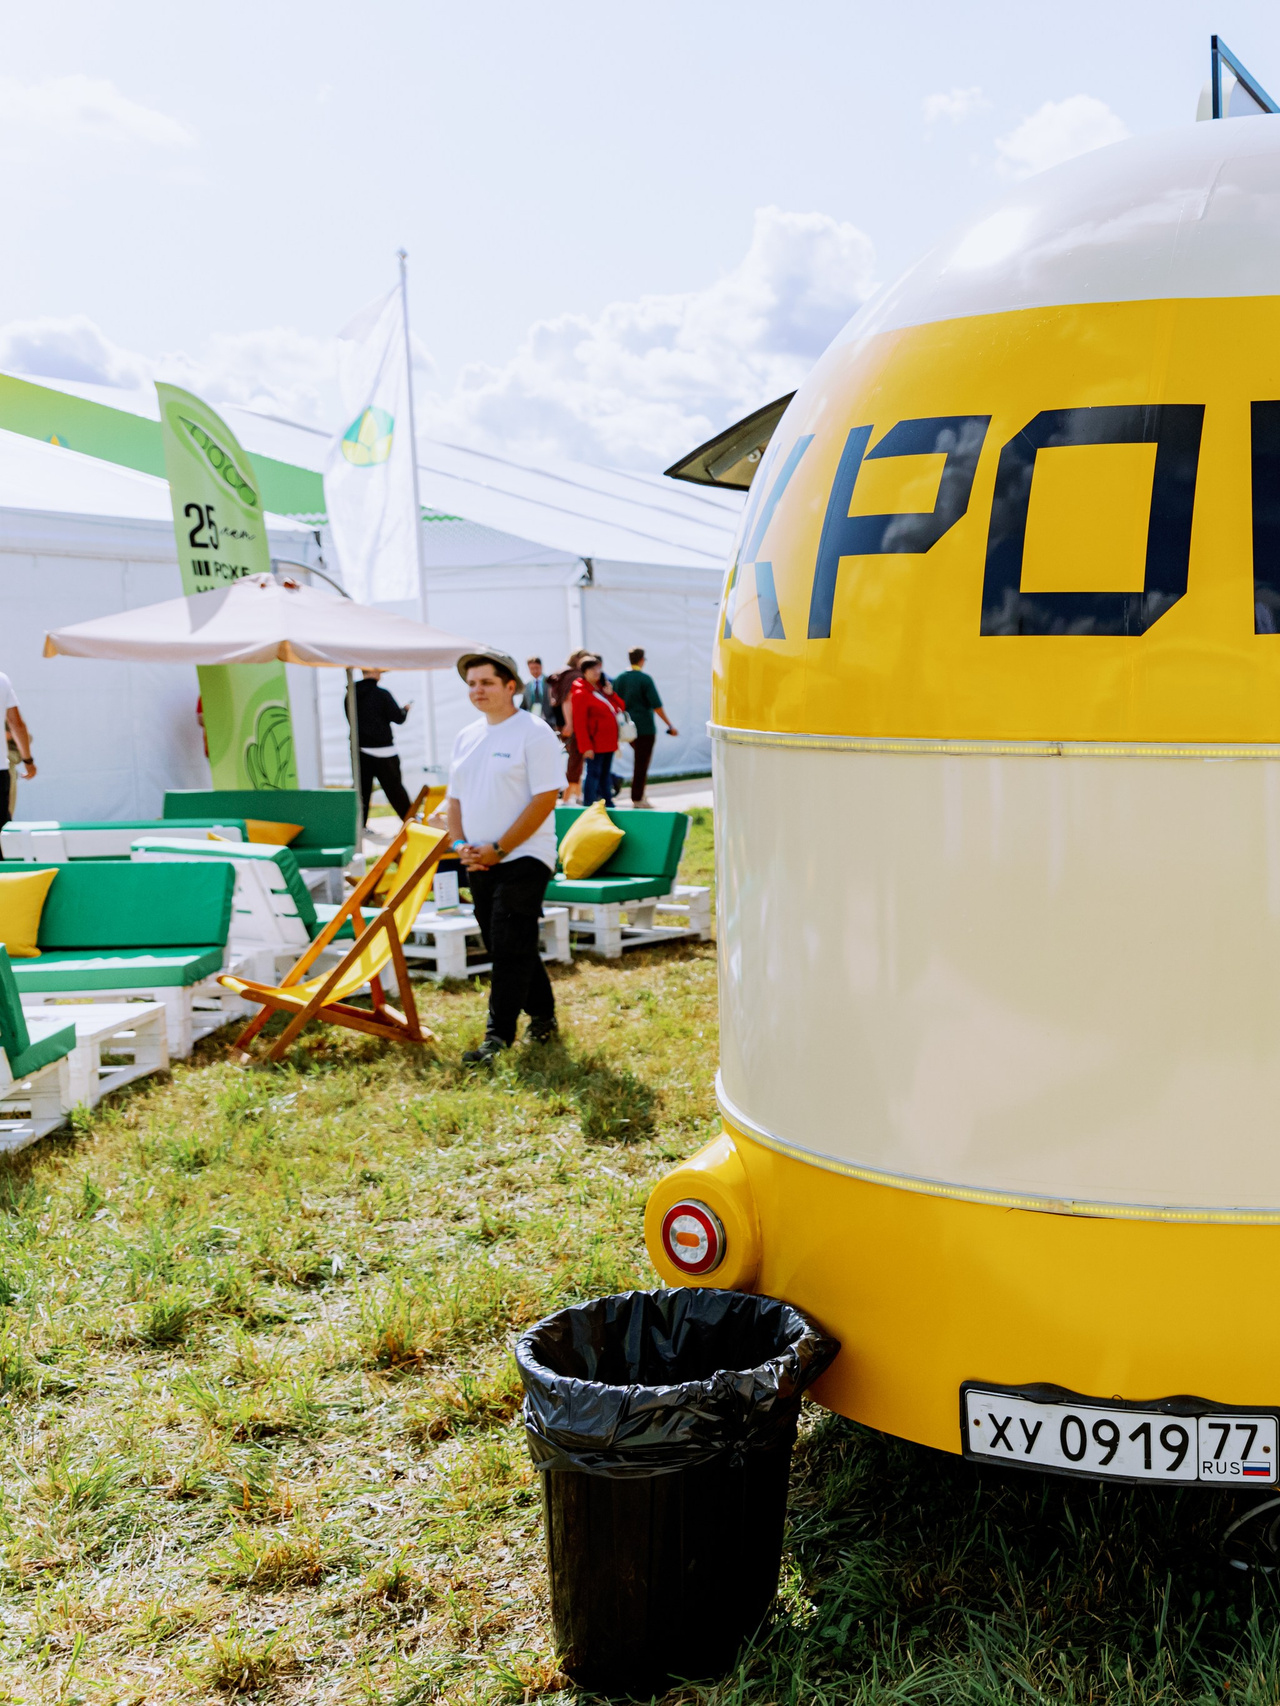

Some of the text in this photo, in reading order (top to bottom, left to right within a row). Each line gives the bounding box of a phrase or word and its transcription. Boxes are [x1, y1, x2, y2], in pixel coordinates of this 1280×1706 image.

[184, 503, 219, 550] 25
[1060, 1415, 1189, 1472] 0919
[1208, 1423, 1258, 1460] 77
[1202, 1461, 1241, 1475] RUS
